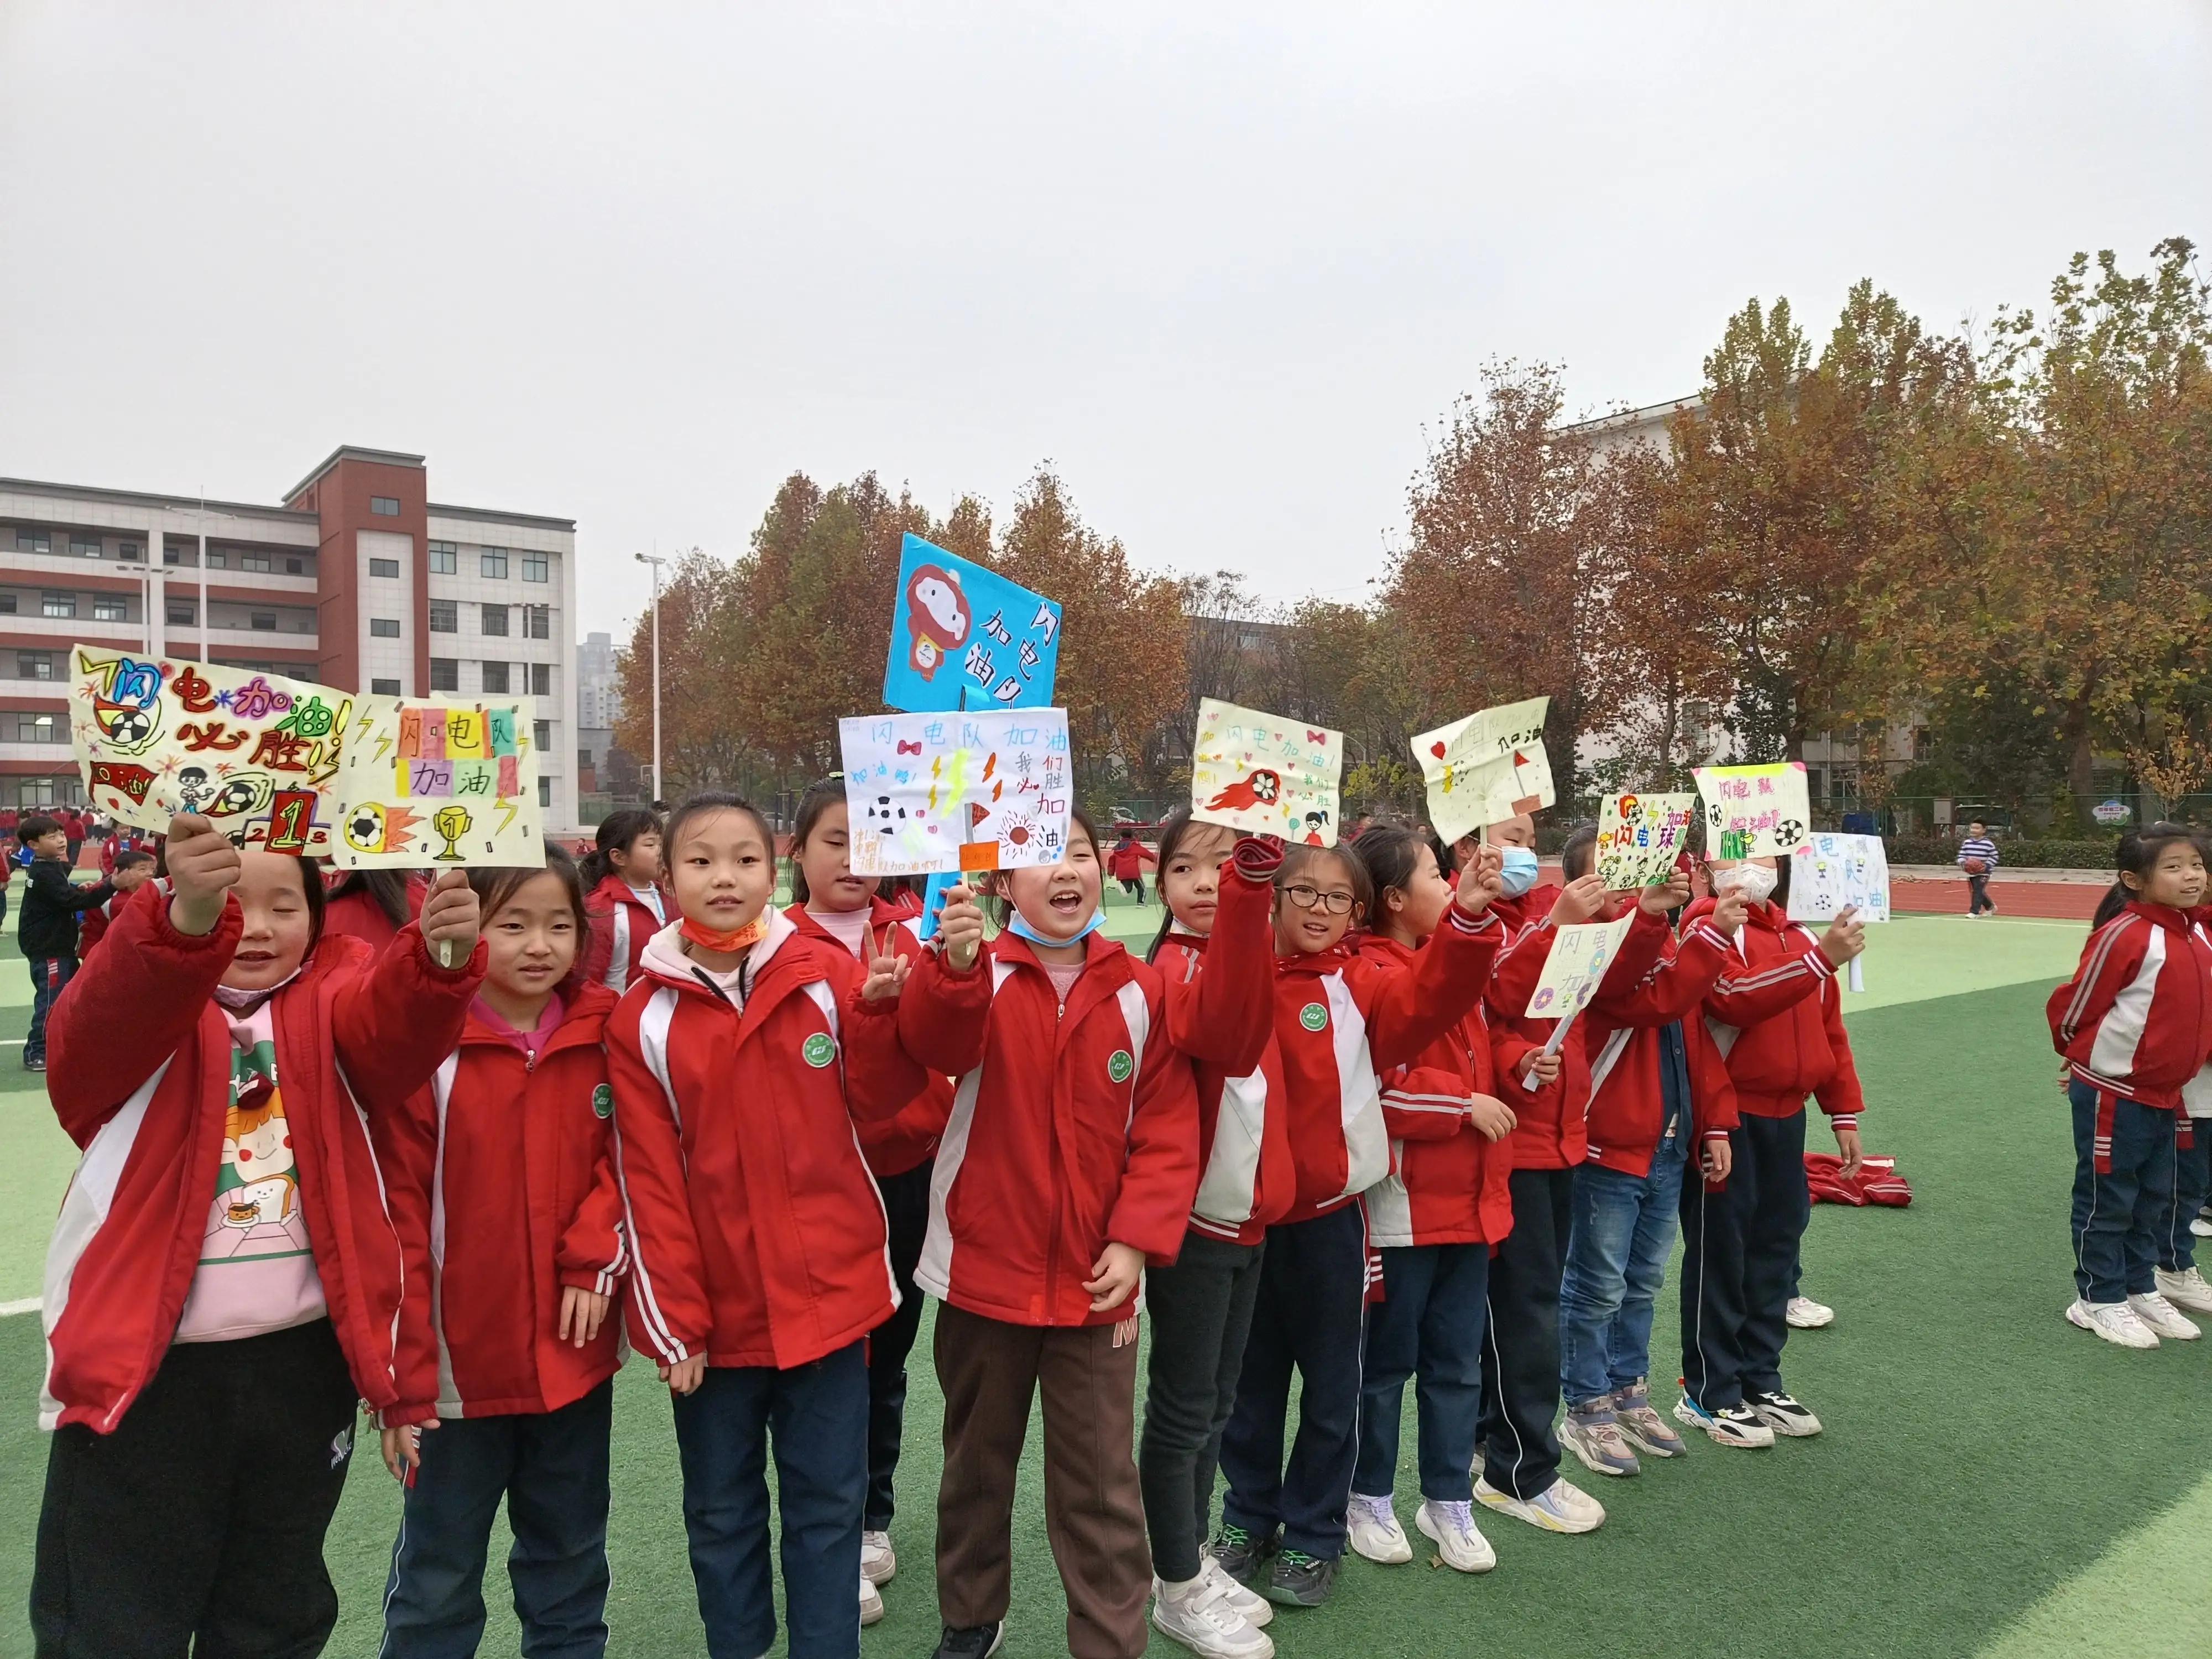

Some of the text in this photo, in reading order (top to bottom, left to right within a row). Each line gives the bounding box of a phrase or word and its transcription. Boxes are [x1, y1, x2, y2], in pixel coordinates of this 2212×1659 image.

[1015, 751, 1063, 773] 我们
[411, 763, 491, 796] 加油
[244, 799, 327, 849] 2 1 3
[442, 817, 456, 838] 1
